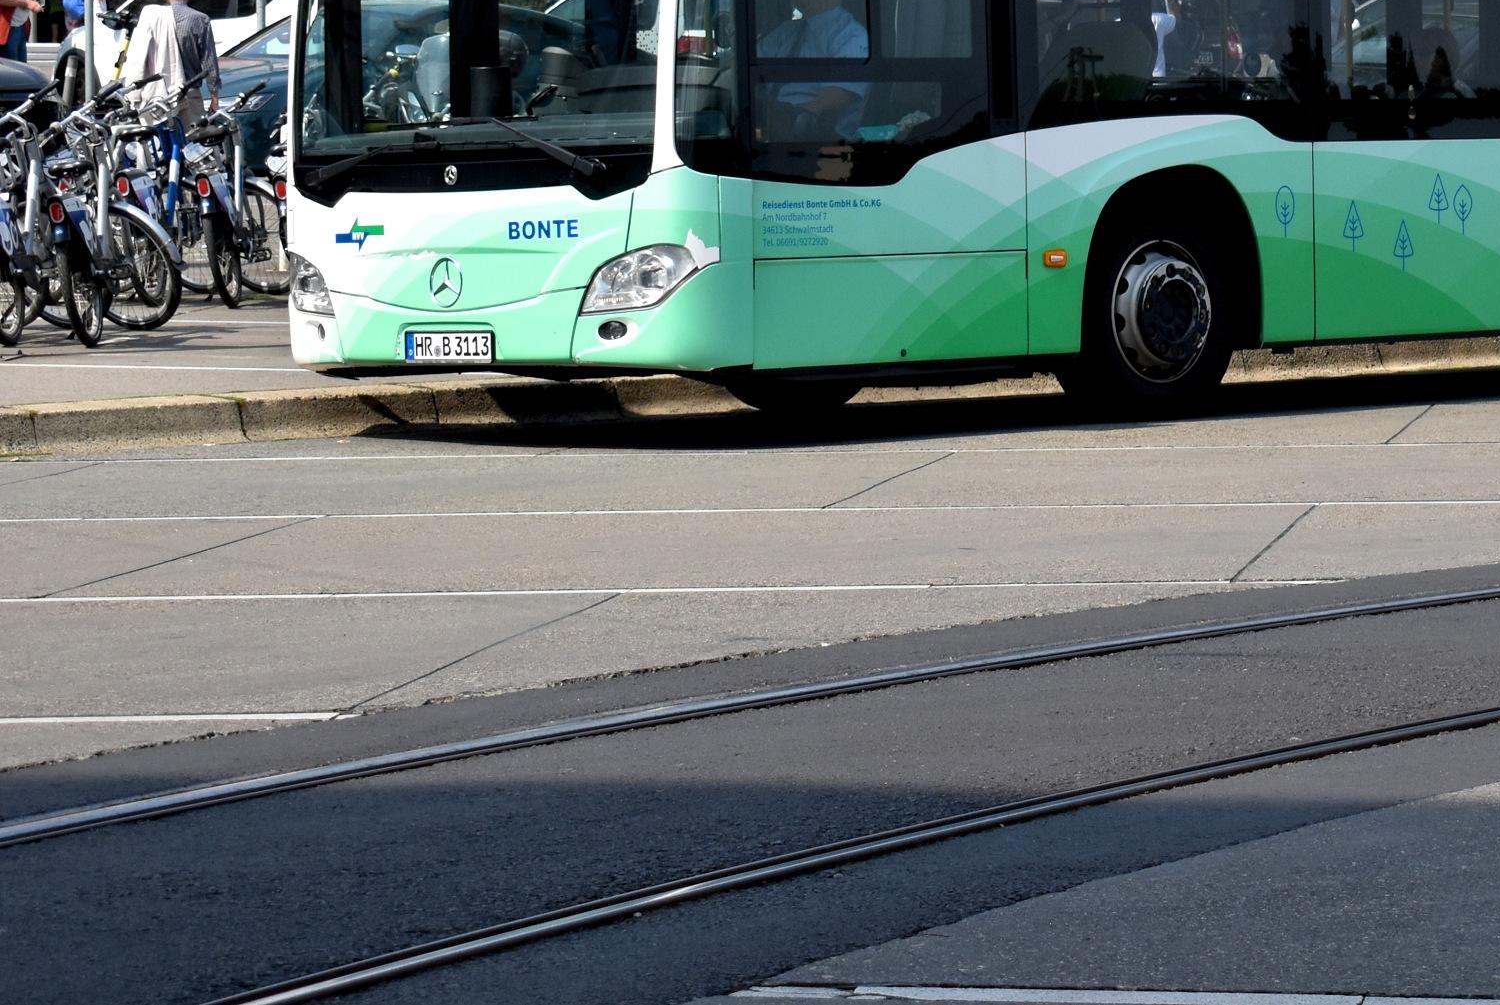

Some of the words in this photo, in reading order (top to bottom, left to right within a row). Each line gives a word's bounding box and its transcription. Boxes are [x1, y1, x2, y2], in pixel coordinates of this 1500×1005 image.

[761, 200, 805, 210] Reisedienst
[806, 199, 829, 209] Bonte
[829, 199, 852, 208] GmbH
[852, 199, 859, 208] &
[762, 213, 774, 222] Am
[775, 212, 822, 222] Nordbahnhof
[508, 219, 580, 240] BONTE
[762, 226, 783, 235] 34613
[784, 224, 834, 235] Schwalmstadt
[415, 336, 432, 357] HR
[442, 336, 452, 356] B
[454, 336, 490, 357] 3113
